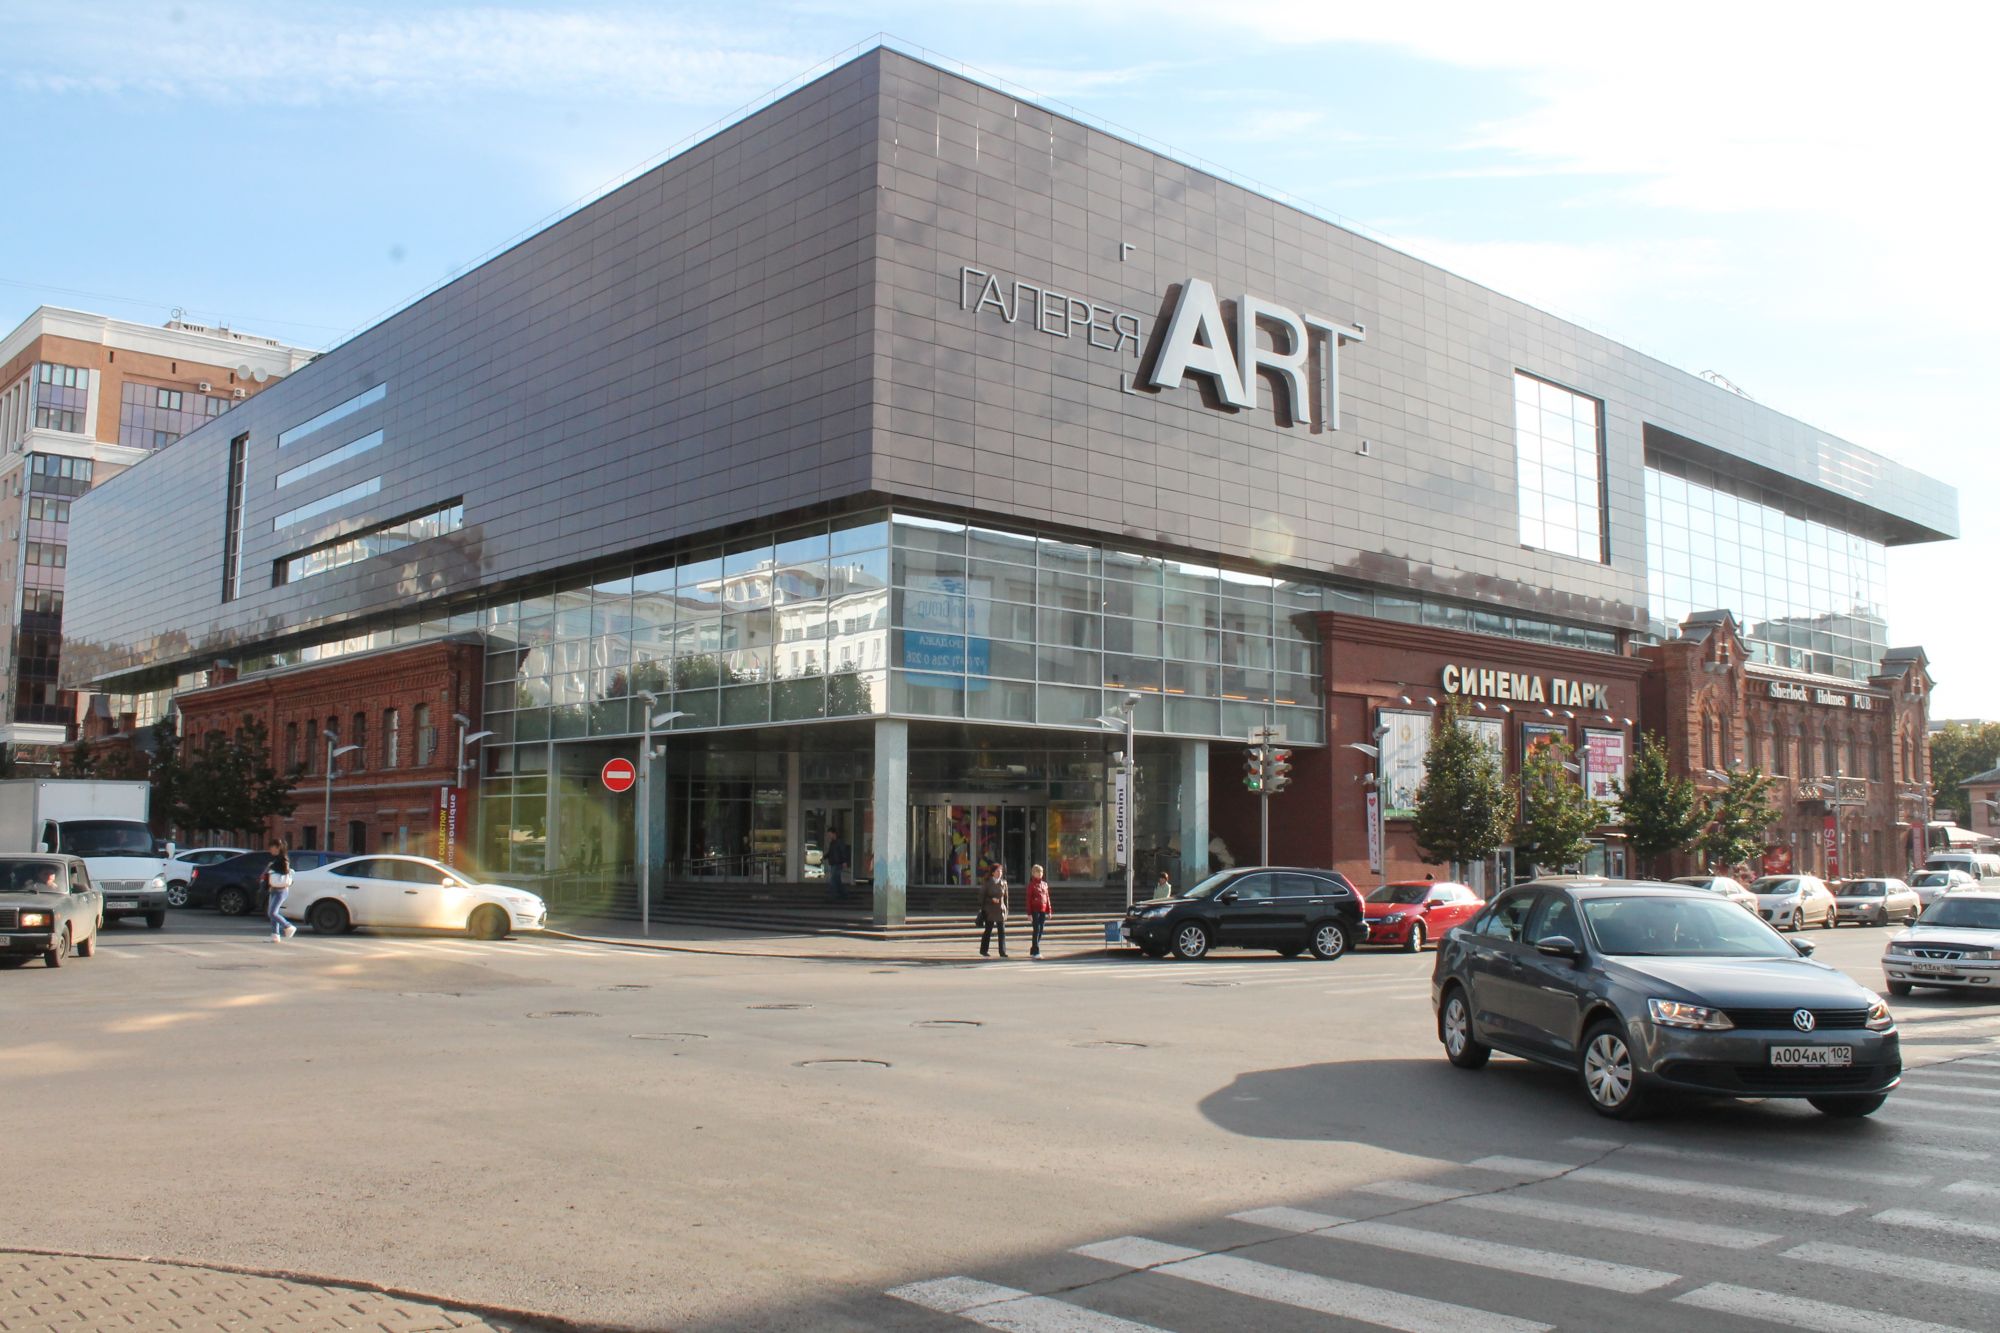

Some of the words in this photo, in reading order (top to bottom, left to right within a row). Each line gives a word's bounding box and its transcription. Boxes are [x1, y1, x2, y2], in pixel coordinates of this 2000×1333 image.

[960, 266, 1140, 358] ГАЛЕРЕЯ
[1149, 278, 1366, 431] ART
[1443, 664, 1545, 703] СИНЕМА
[1552, 678, 1608, 710] ПАРК
[1770, 682, 1808, 702] Sherlock
[1816, 689, 1846, 706] Holmes
[1854, 694, 1872, 710] PUB
[1824, 828, 1838, 865] SALE
[1830, 1047, 1850, 1059] 102
